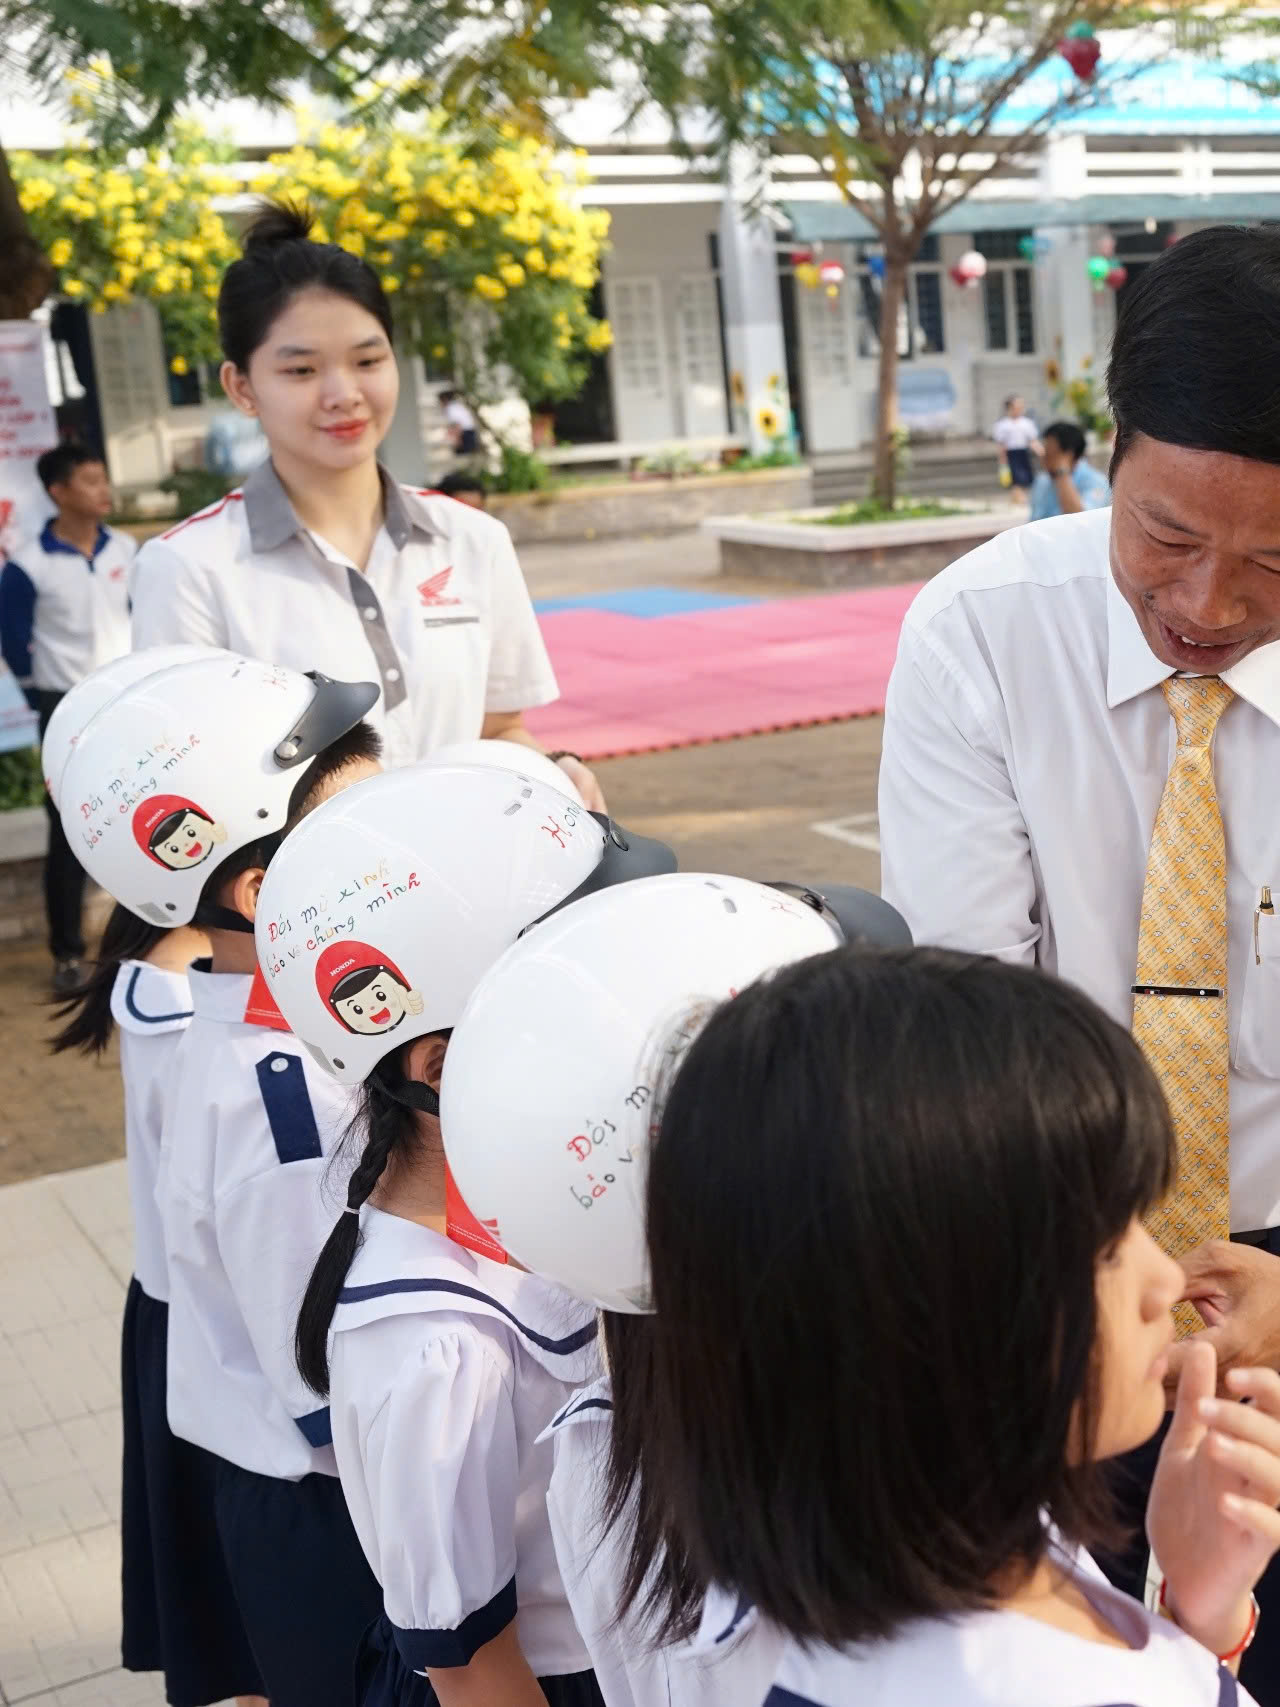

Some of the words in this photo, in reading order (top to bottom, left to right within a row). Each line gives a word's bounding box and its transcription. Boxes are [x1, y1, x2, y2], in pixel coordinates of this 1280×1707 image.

[306, 916, 355, 950] chúng
[329, 958, 356, 977] HONDA
[570, 1173, 615, 1210] bảo
